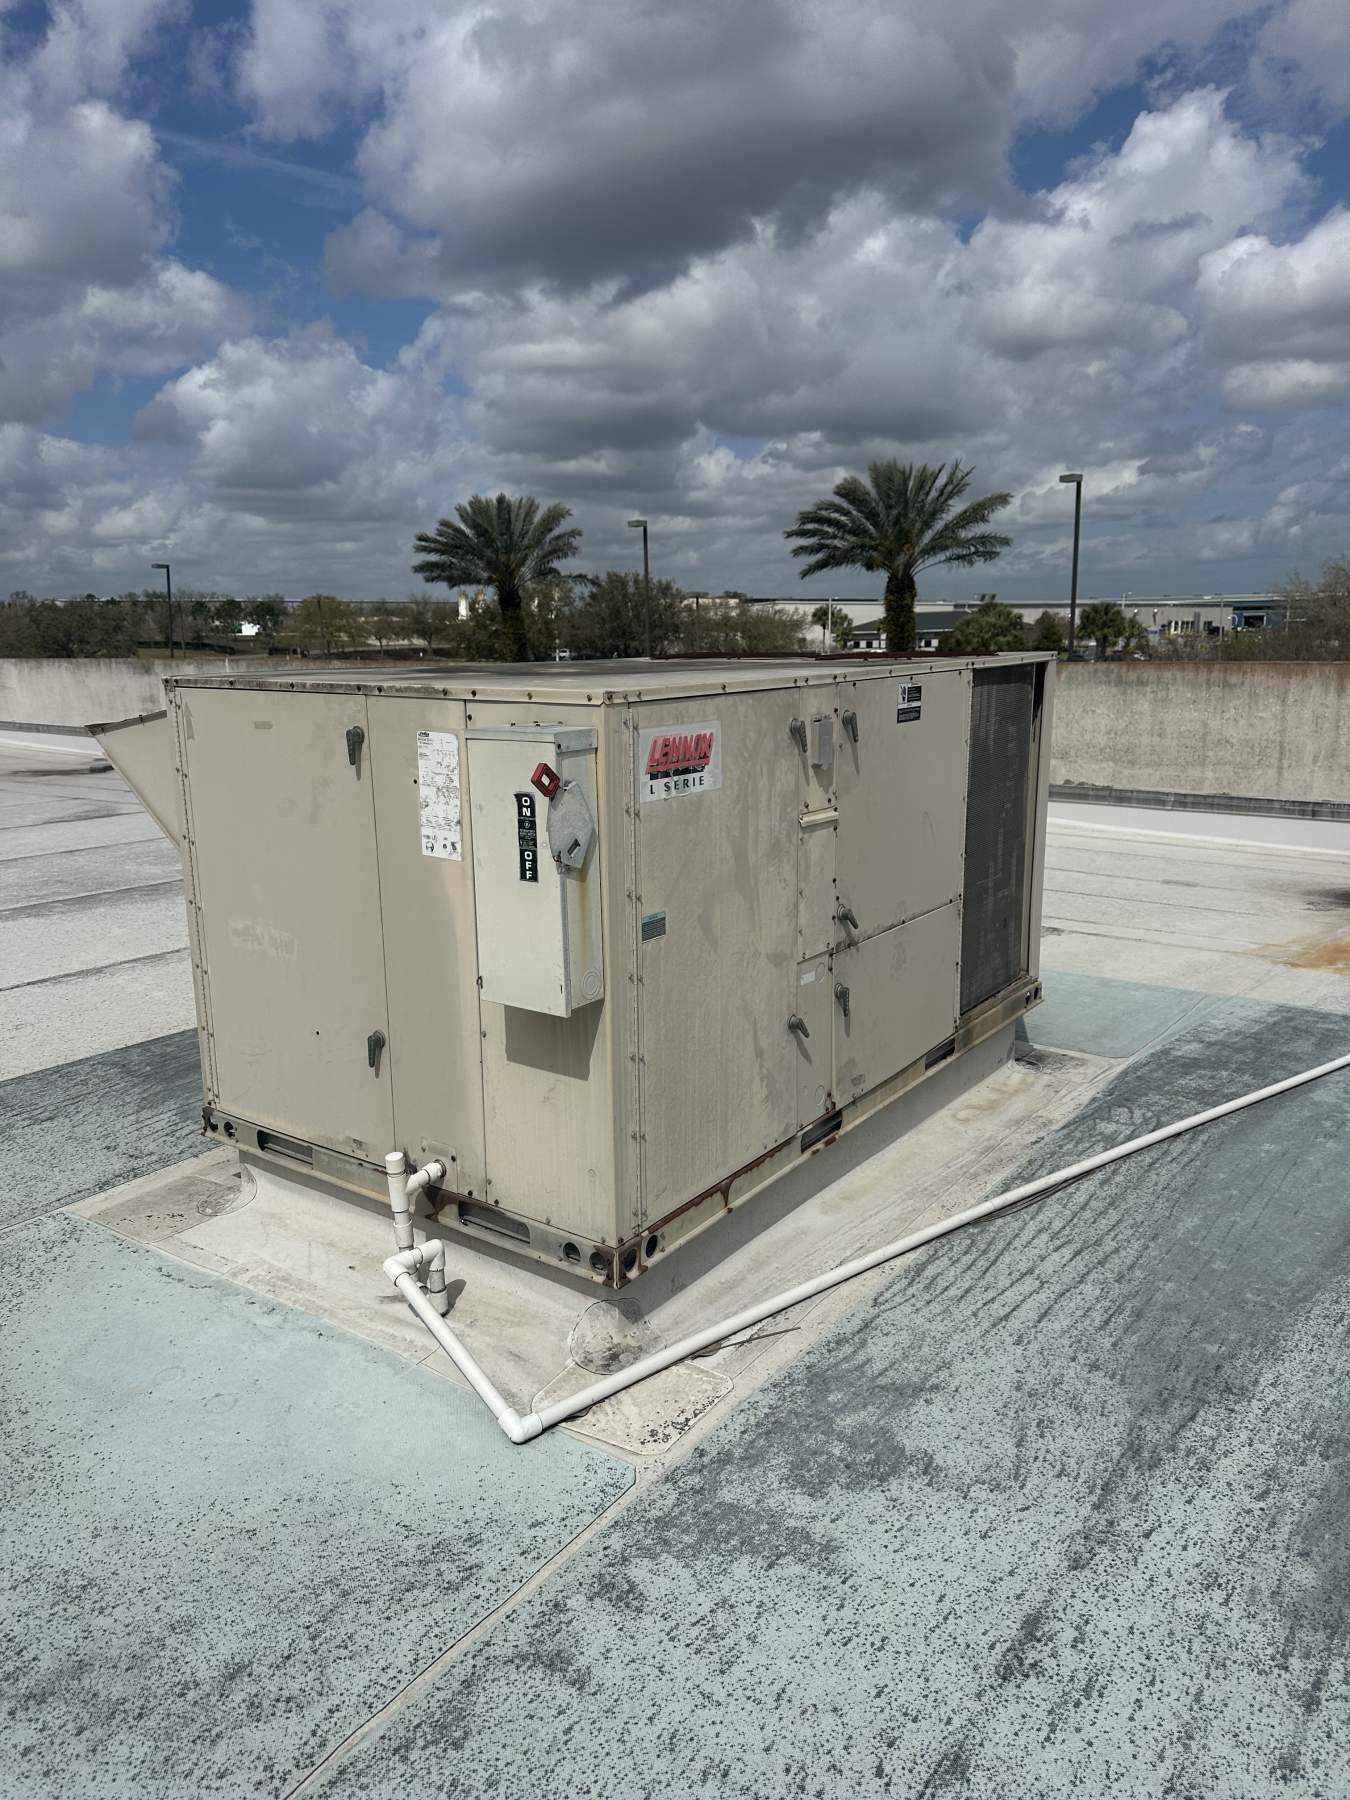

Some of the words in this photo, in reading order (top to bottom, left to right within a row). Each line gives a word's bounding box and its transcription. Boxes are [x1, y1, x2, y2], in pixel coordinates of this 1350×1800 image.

[648, 732, 715, 767] LENNOX
[649, 784, 656, 795] L
[522, 797, 531, 817] ON
[524, 851, 533, 880] OFF
